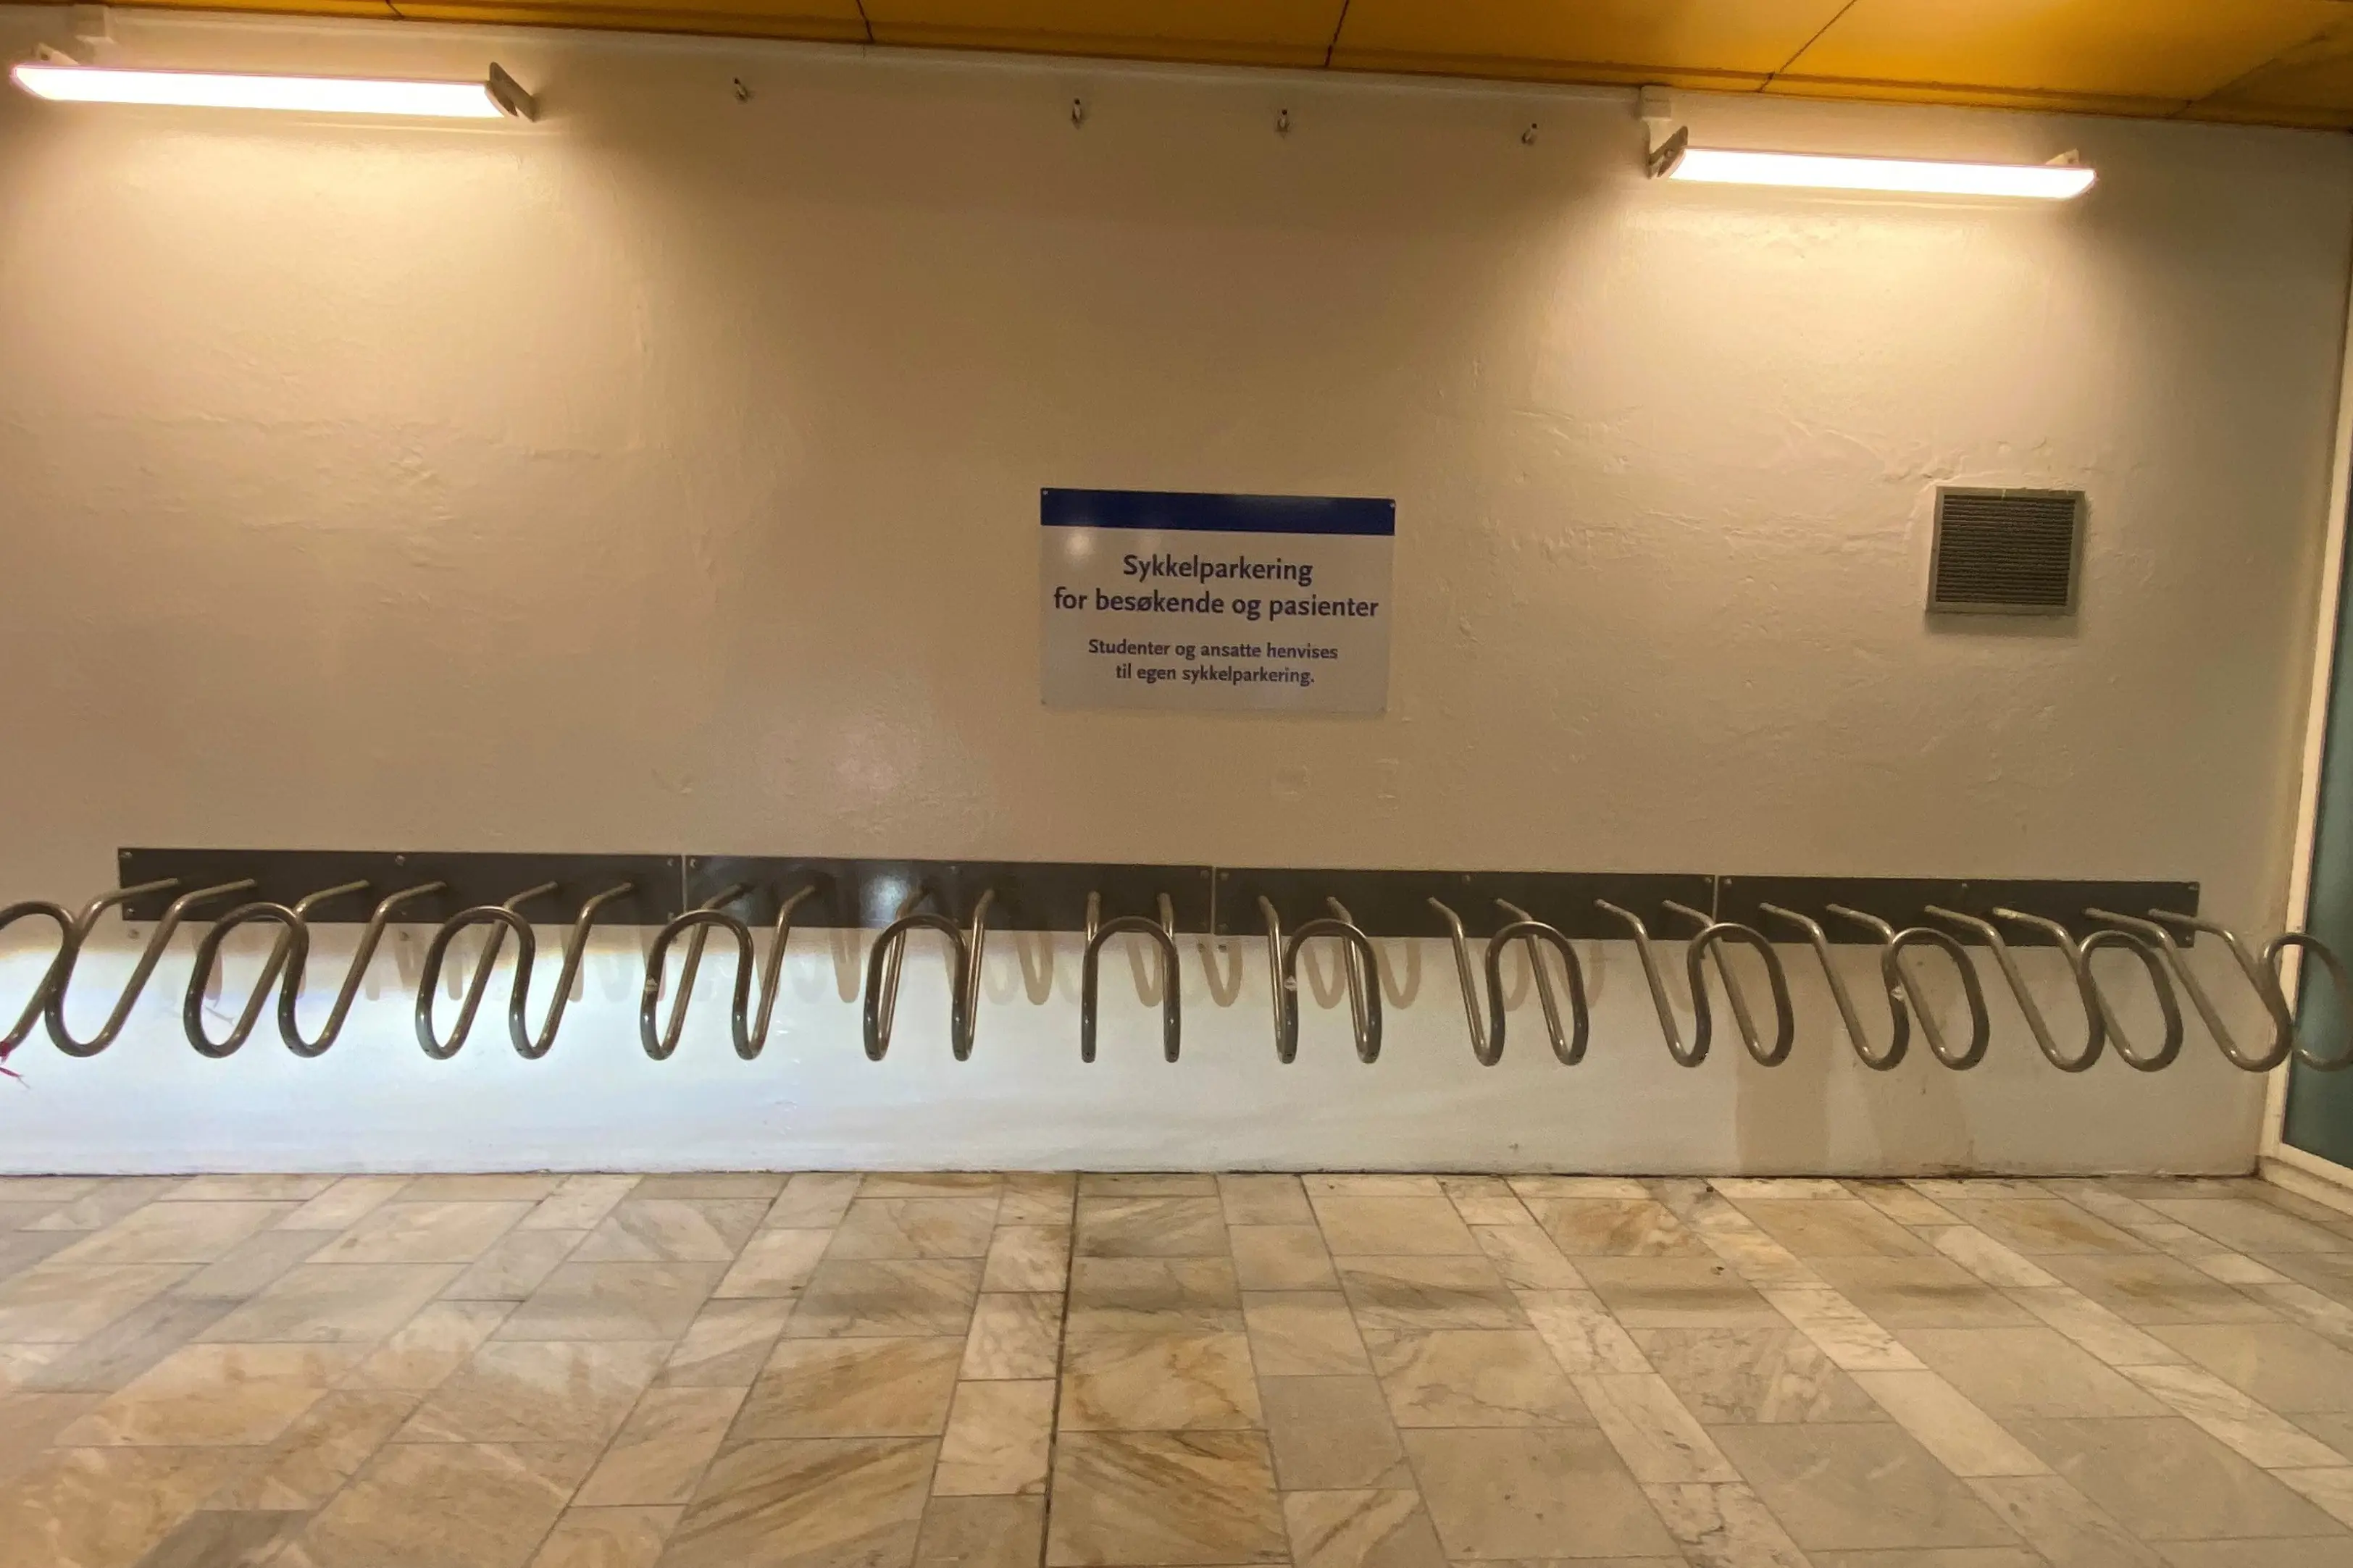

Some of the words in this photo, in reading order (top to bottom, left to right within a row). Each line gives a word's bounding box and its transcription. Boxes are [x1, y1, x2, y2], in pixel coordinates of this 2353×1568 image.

[1124, 553, 1313, 587] Sykkelparkering
[1053, 587, 1087, 610] for
[1095, 588, 1224, 613] besøkende
[1232, 599, 1261, 621] og
[1270, 594, 1379, 621] pasienter
[1089, 639, 1171, 655] Studenter
[1175, 645, 1196, 661] og
[1201, 644, 1261, 658] ansatte
[1267, 642, 1337, 659] henvises
[1116, 663, 1131, 679] til
[1137, 668, 1176, 684] egen
[1182, 665, 1314, 687] sykkelparkering.
